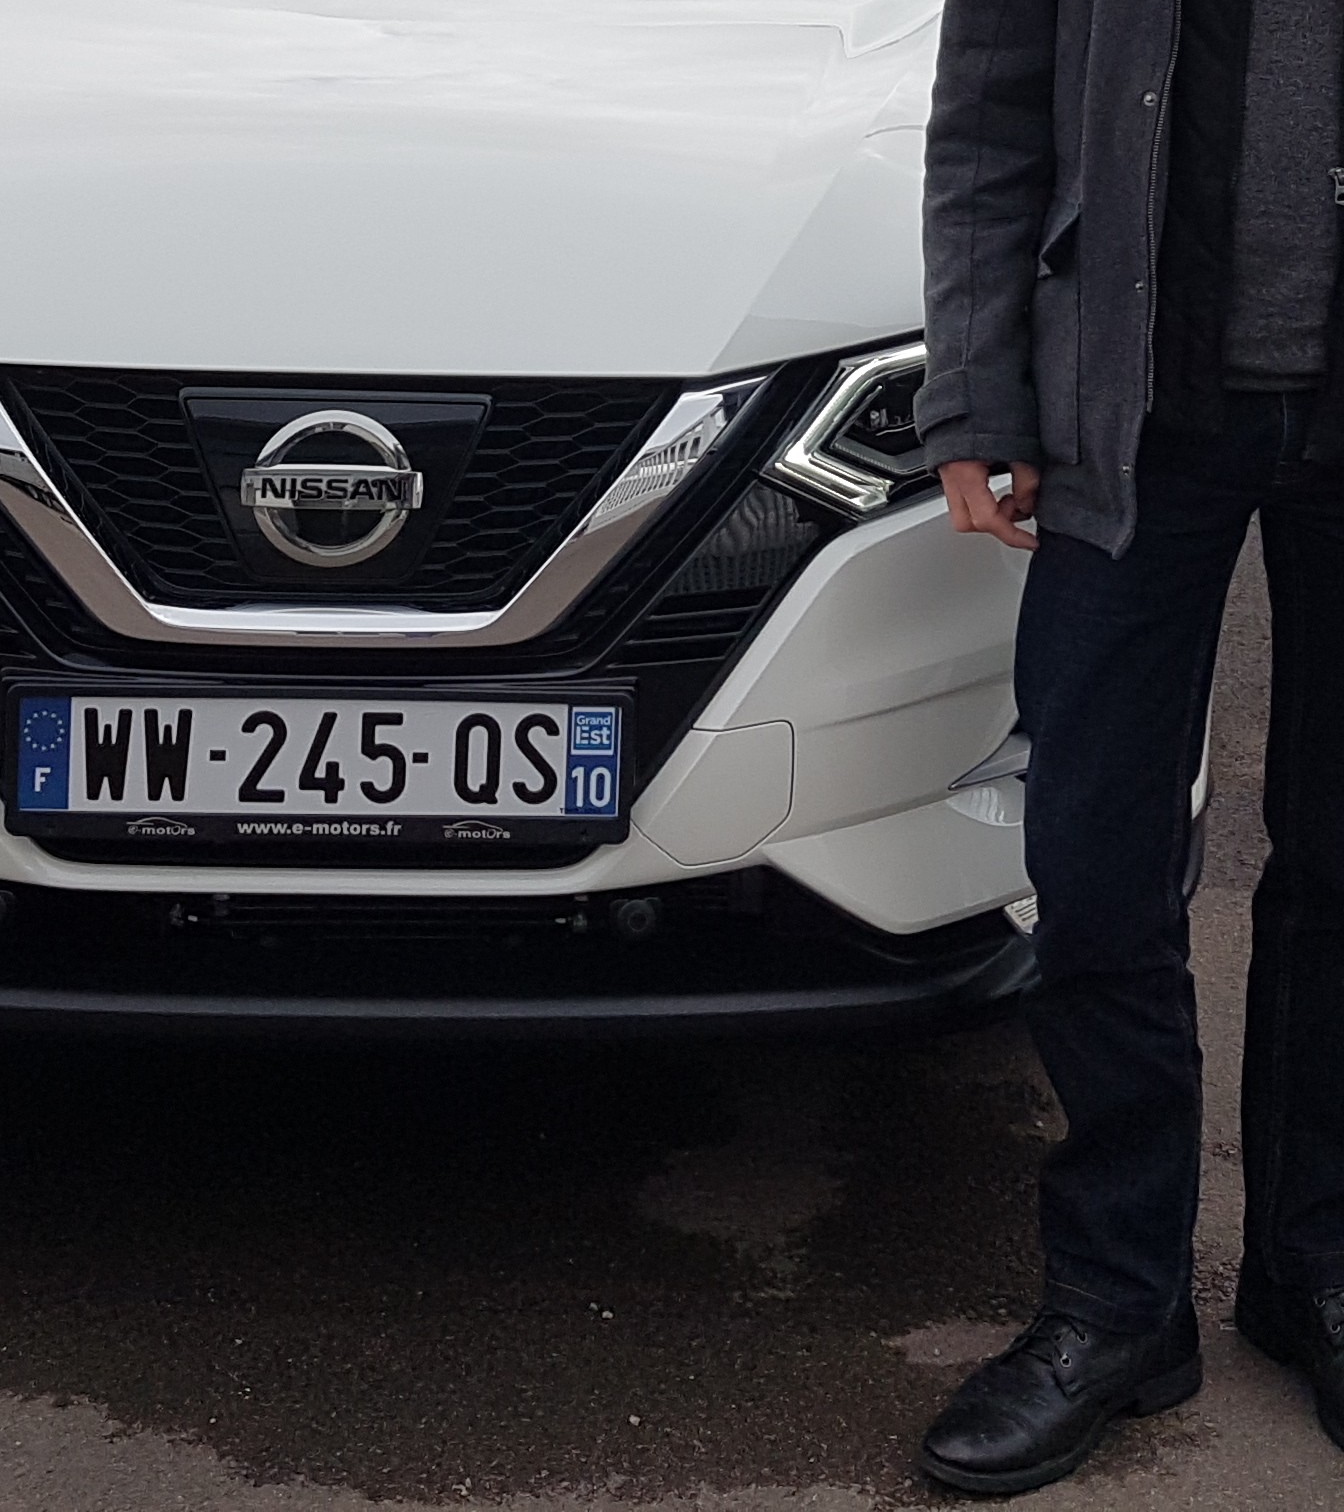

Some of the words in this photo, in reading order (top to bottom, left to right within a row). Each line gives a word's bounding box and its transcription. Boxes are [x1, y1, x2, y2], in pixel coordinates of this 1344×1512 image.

[260, 476, 405, 502] NISSAN
[576, 715, 611, 725] Grand
[575, 726, 611, 745] Est
[33, 767, 51, 792] F
[571, 766, 612, 808] 10
[237, 820, 402, 835] www.e-motors.fr
